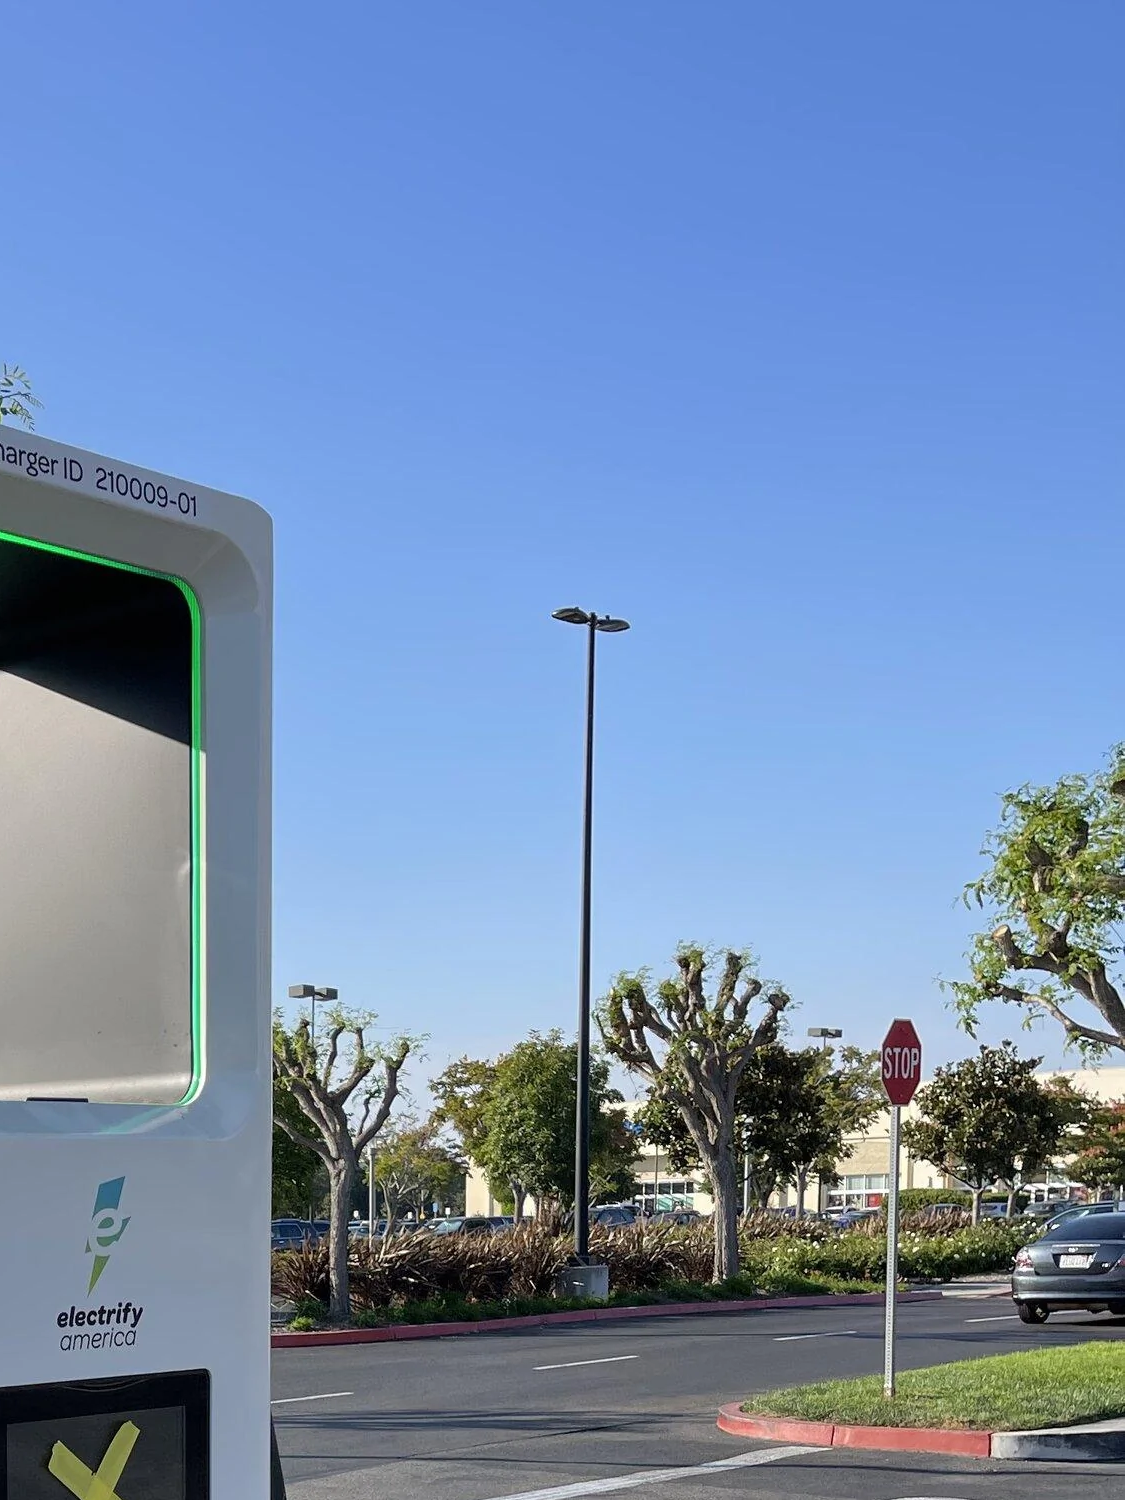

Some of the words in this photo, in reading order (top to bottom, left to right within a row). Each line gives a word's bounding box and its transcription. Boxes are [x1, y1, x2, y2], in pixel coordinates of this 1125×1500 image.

[63, 457, 84, 482] ID
[95, 467, 197, 517] 210009-01
[883, 1046, 920, 1079] STOP
[56, 1302, 144, 1328] electrify
[60, 1327, 137, 1351] america
